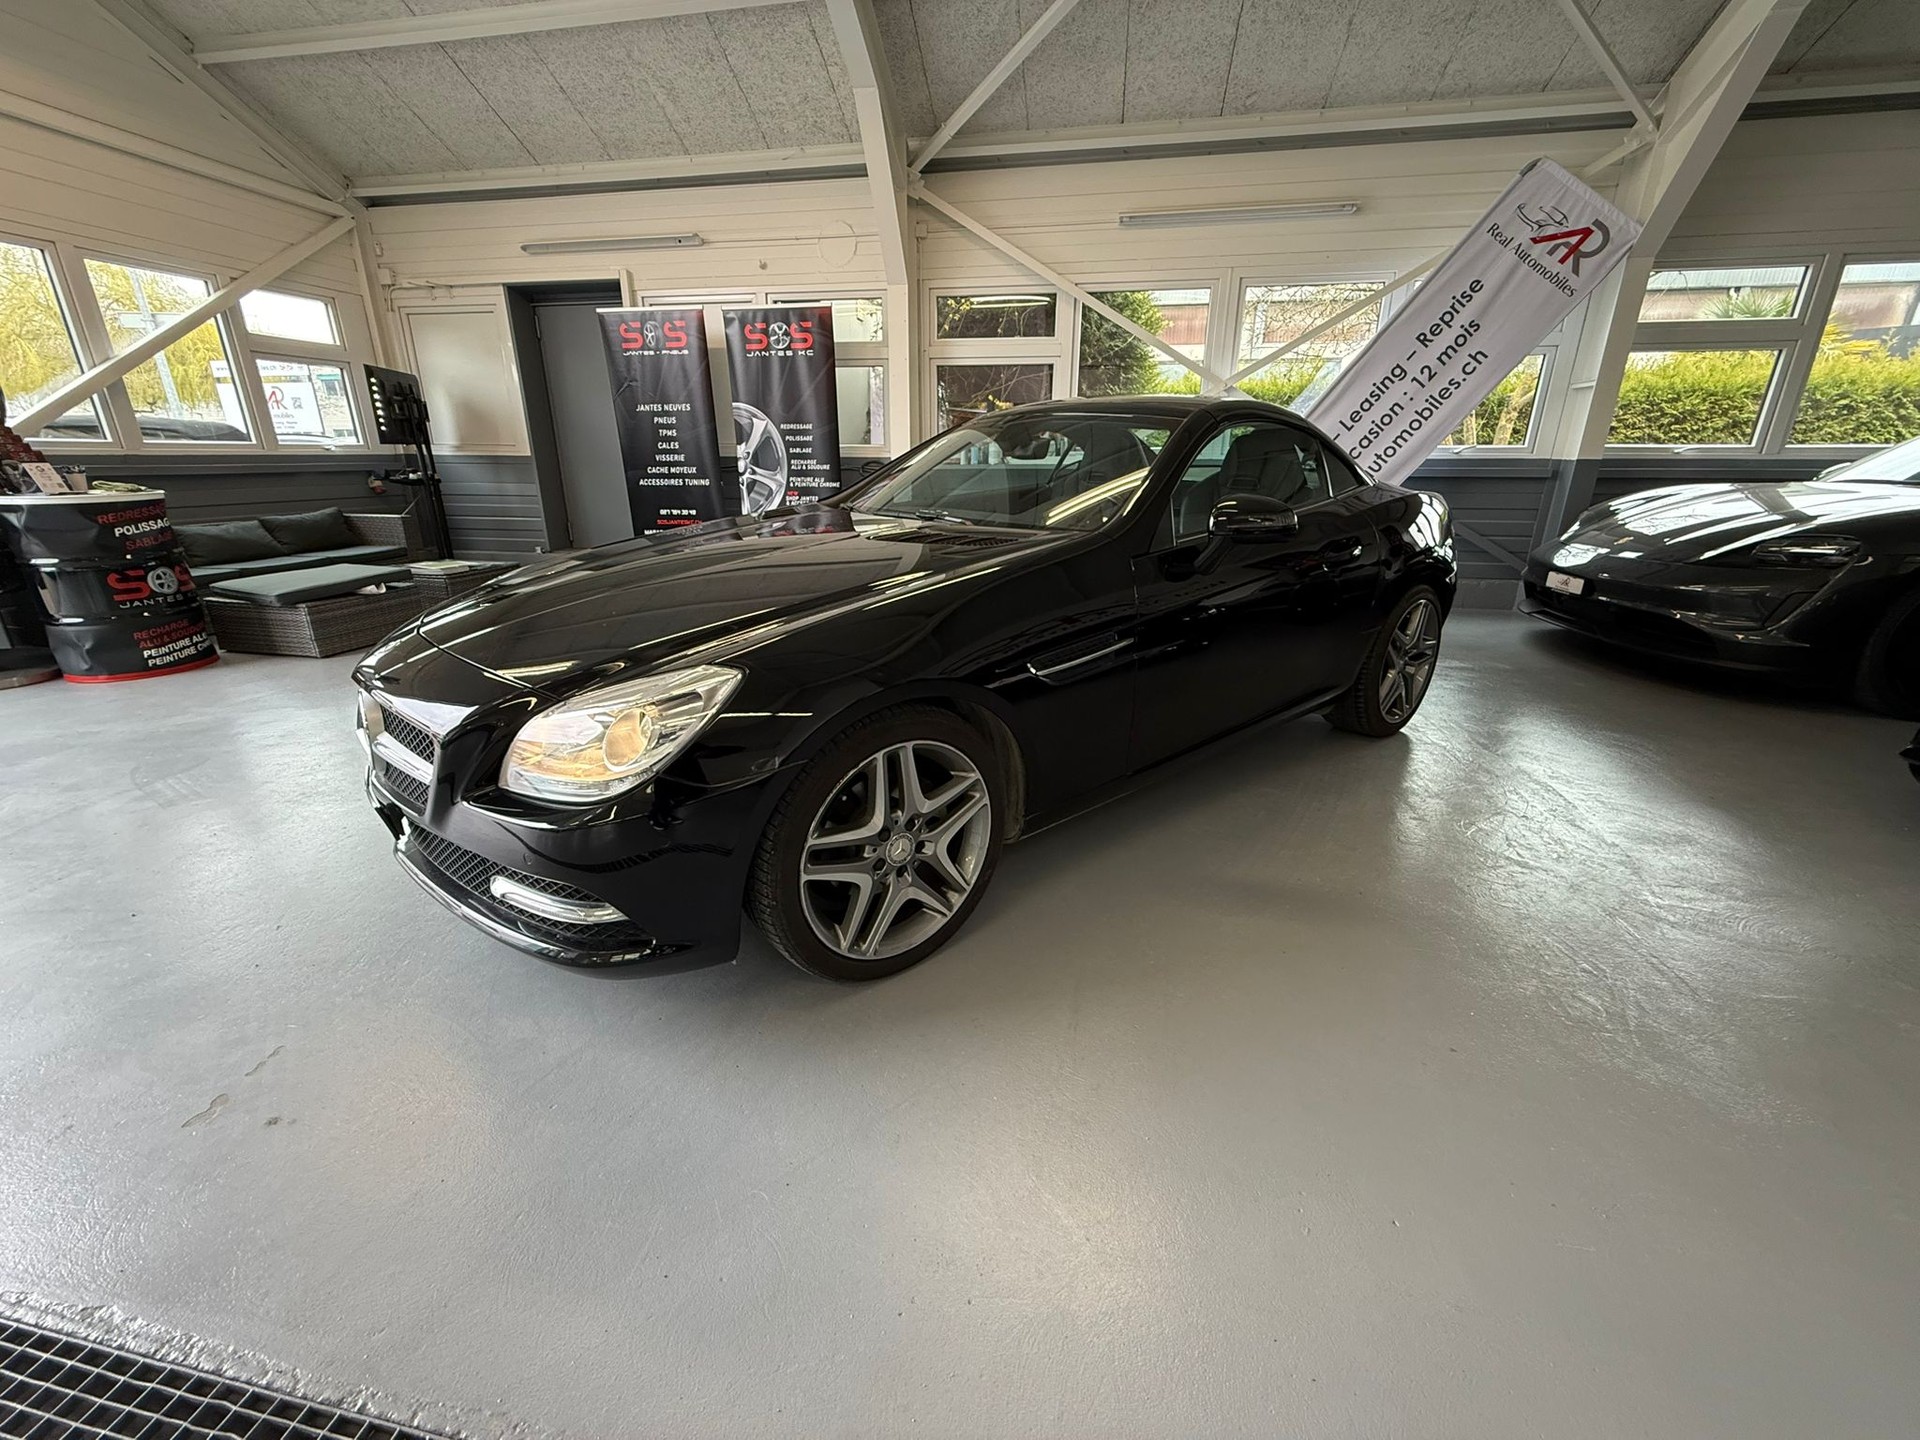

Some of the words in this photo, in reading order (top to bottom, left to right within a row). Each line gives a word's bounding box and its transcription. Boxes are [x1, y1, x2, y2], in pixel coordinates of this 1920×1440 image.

[1486, 222, 1514, 249] Real
[1508, 242, 1578, 298] Automobiles
[744, 321, 814, 351] SOS
[1339, 363, 1408, 432] Leasing
[1415, 278, 1484, 349] Reprise
[1411, 364, 1438, 389] 12
[1440, 318, 1481, 367] mois
[636, 404, 662, 412] JANTES
[663, 403, 691, 411] NEUVES
[653, 416, 677, 424] PNEUS
[658, 429, 677, 437] TPMS
[657, 441, 679, 449] CALES
[655, 454, 685, 462] VISSERIE
[647, 466, 669, 474] CACHE
[670, 466, 697, 474] MOYEUX
[639, 478, 683, 486] ACCESSOIRES
[684, 478, 710, 486] TUNING
[119, 593, 183, 609] JANTES
[143, 637, 192, 659] PEINTURE
[147, 645, 197, 668] PEINTURE
